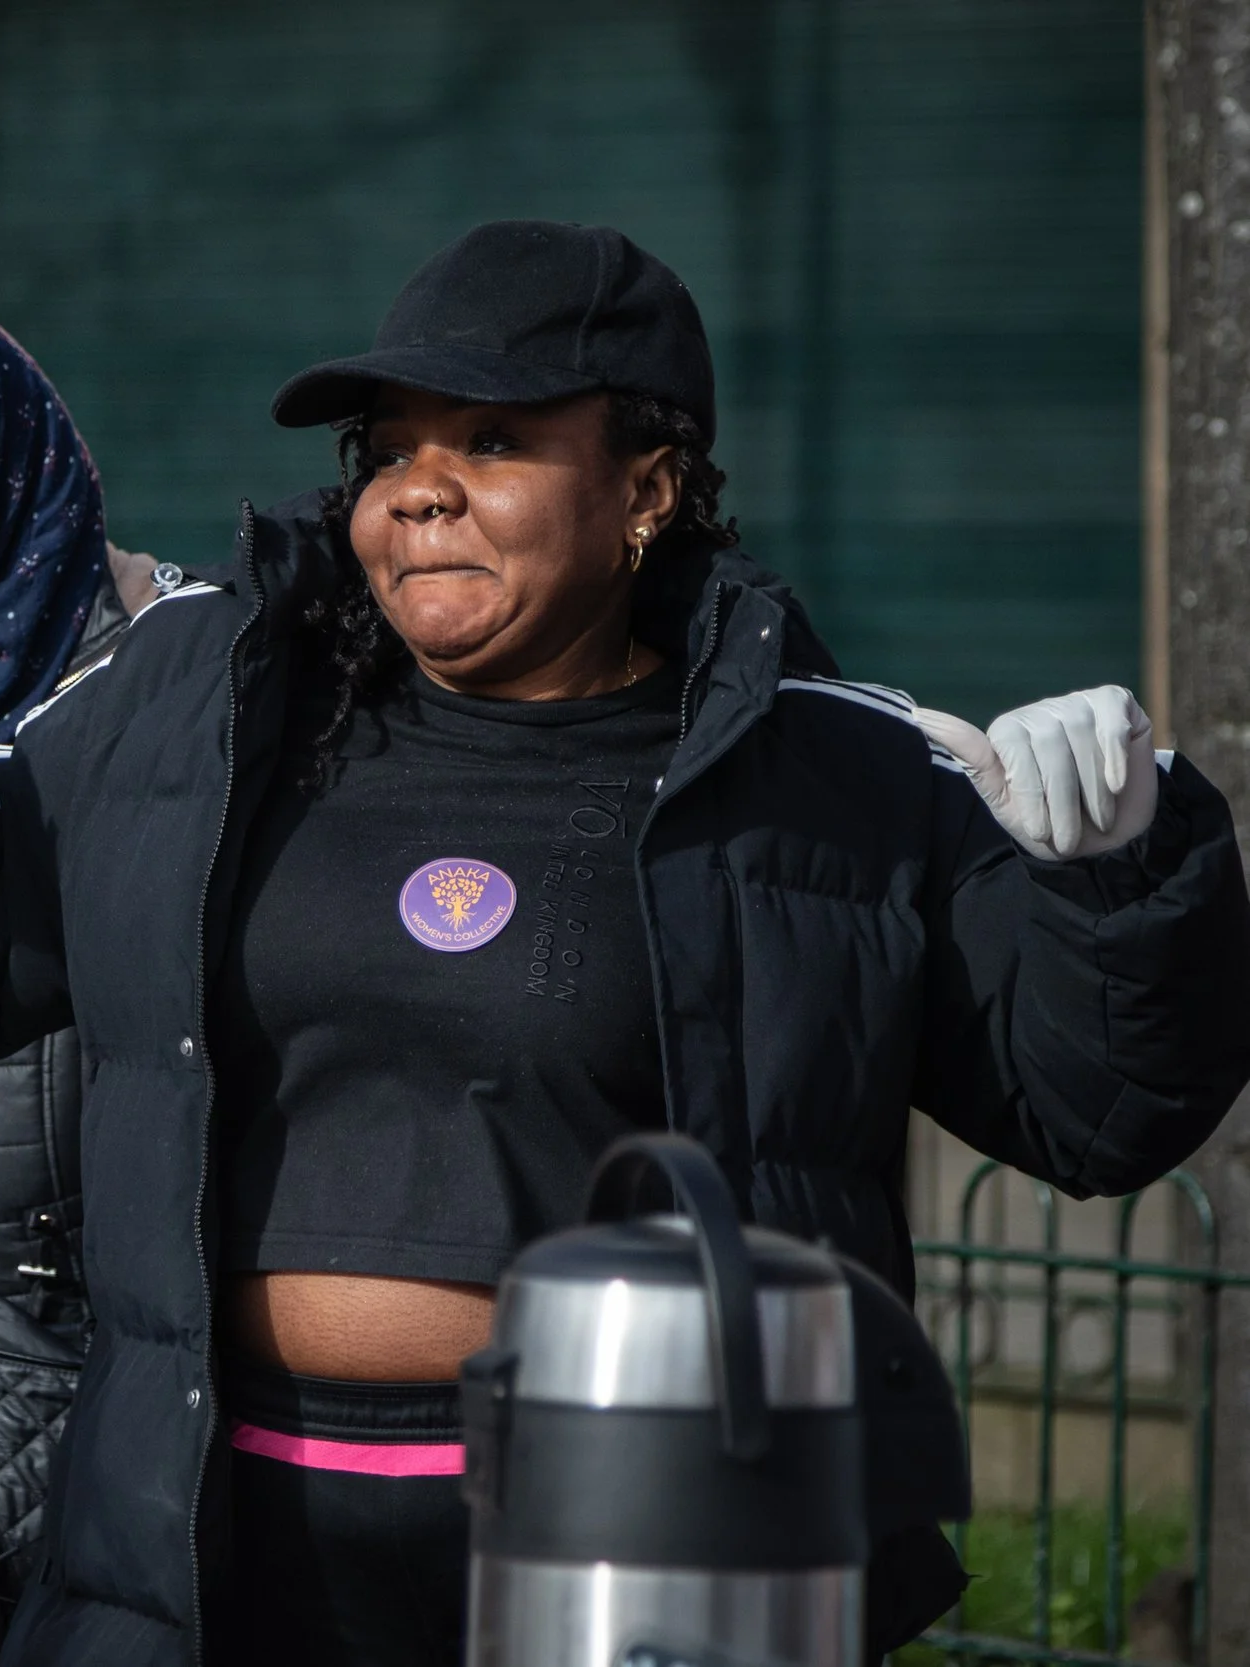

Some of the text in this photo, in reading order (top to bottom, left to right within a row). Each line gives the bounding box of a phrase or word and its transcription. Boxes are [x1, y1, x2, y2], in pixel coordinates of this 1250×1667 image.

[428, 867, 490, 885] ANAKA
[412, 905, 506, 941] WOMEN'S COLLECTIVE
[525, 900, 558, 996] KINGDOM
